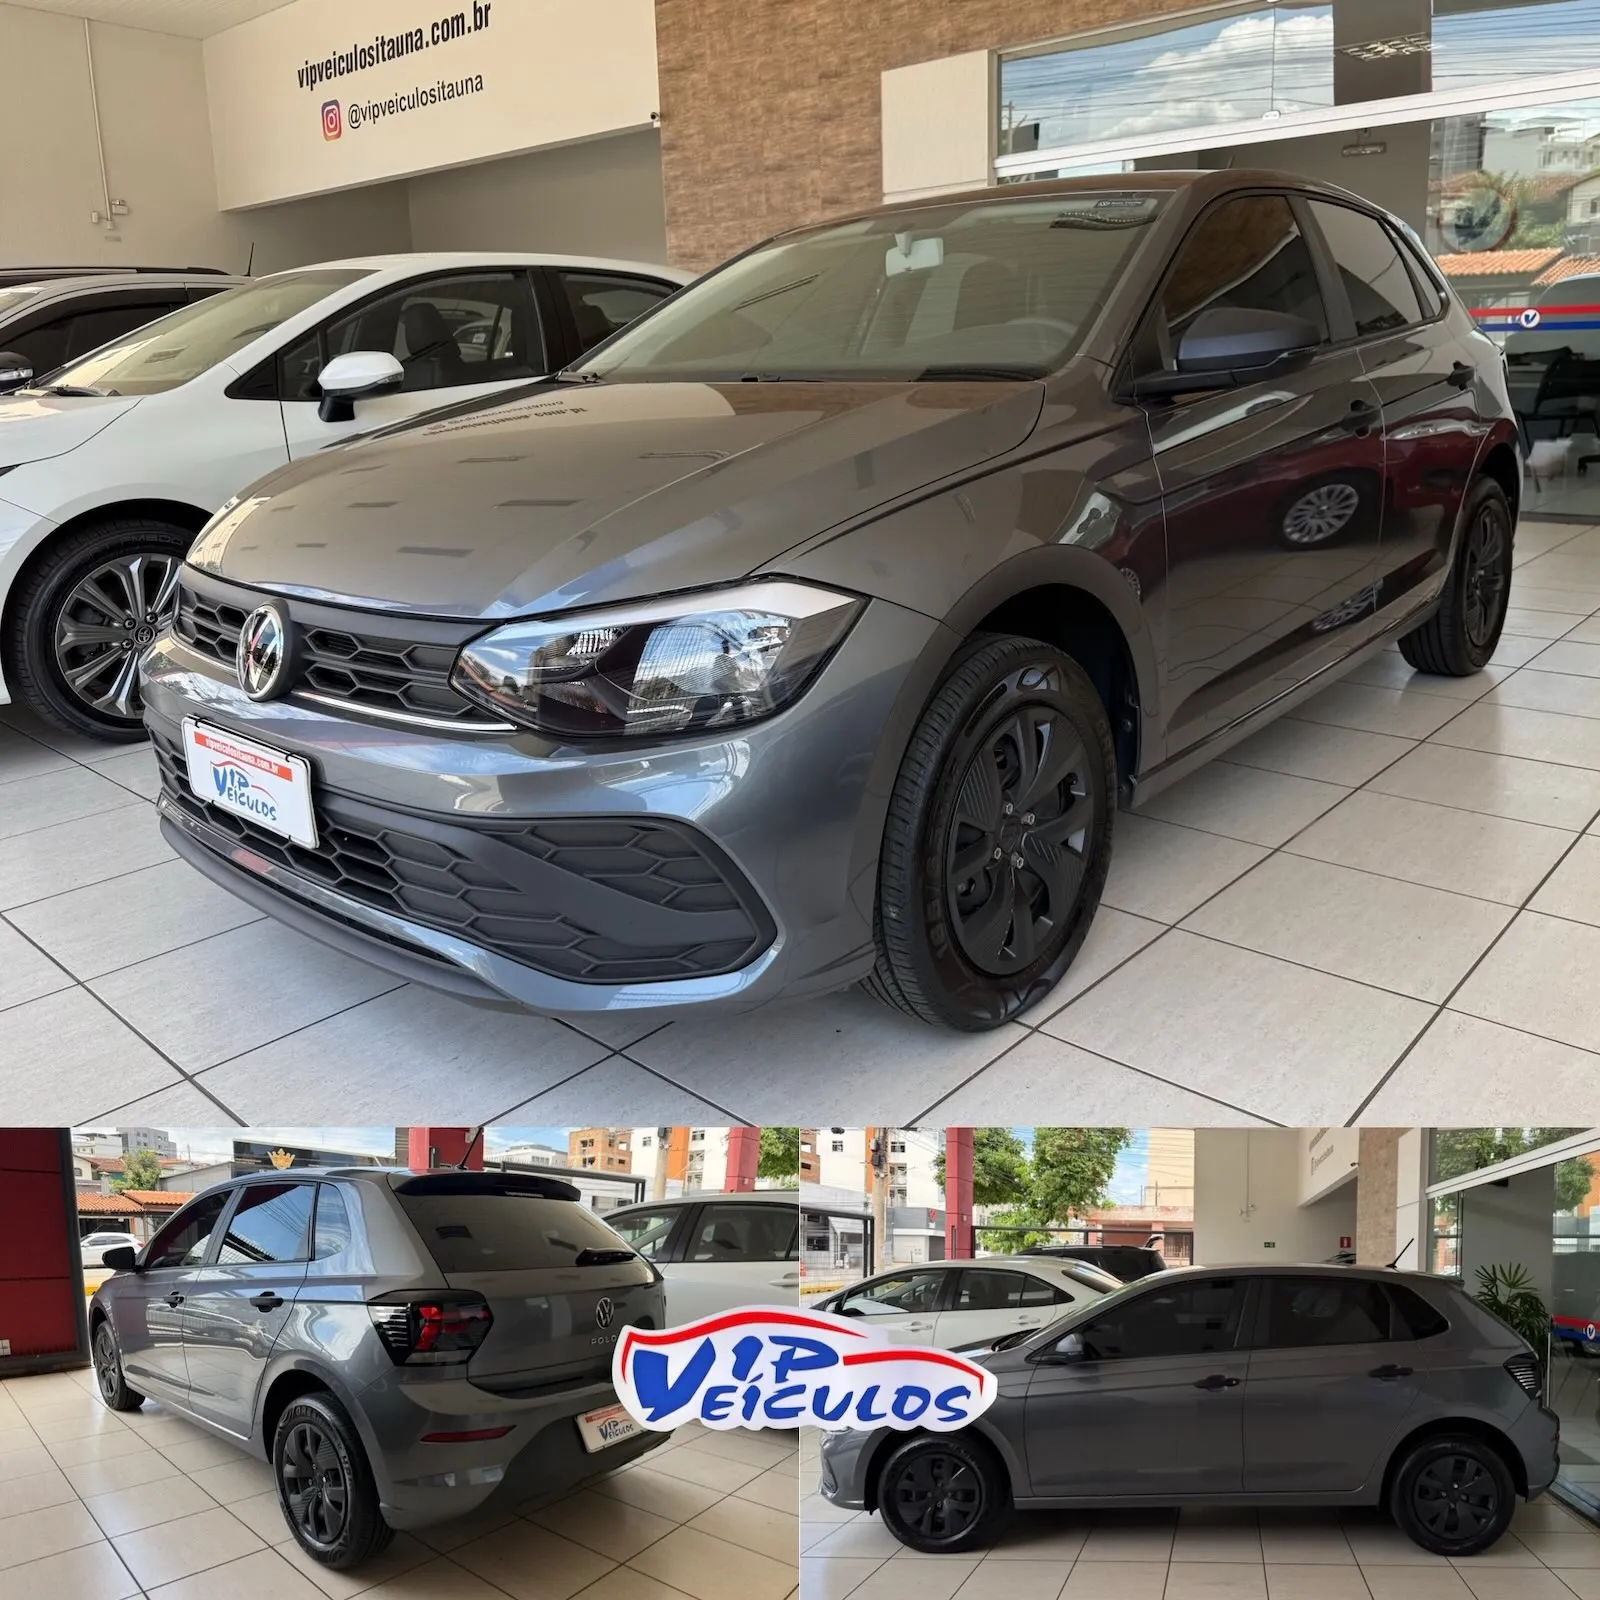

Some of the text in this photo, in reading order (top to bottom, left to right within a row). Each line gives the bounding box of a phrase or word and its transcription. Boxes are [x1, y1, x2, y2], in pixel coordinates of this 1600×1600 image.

[297, 1, 491, 92] vipveiculositauna.com.br
[347, 73, 484, 130] @vipveiculositauna
[212, 766, 250, 797] VIP
[591, 1334, 617, 1345] POLO
